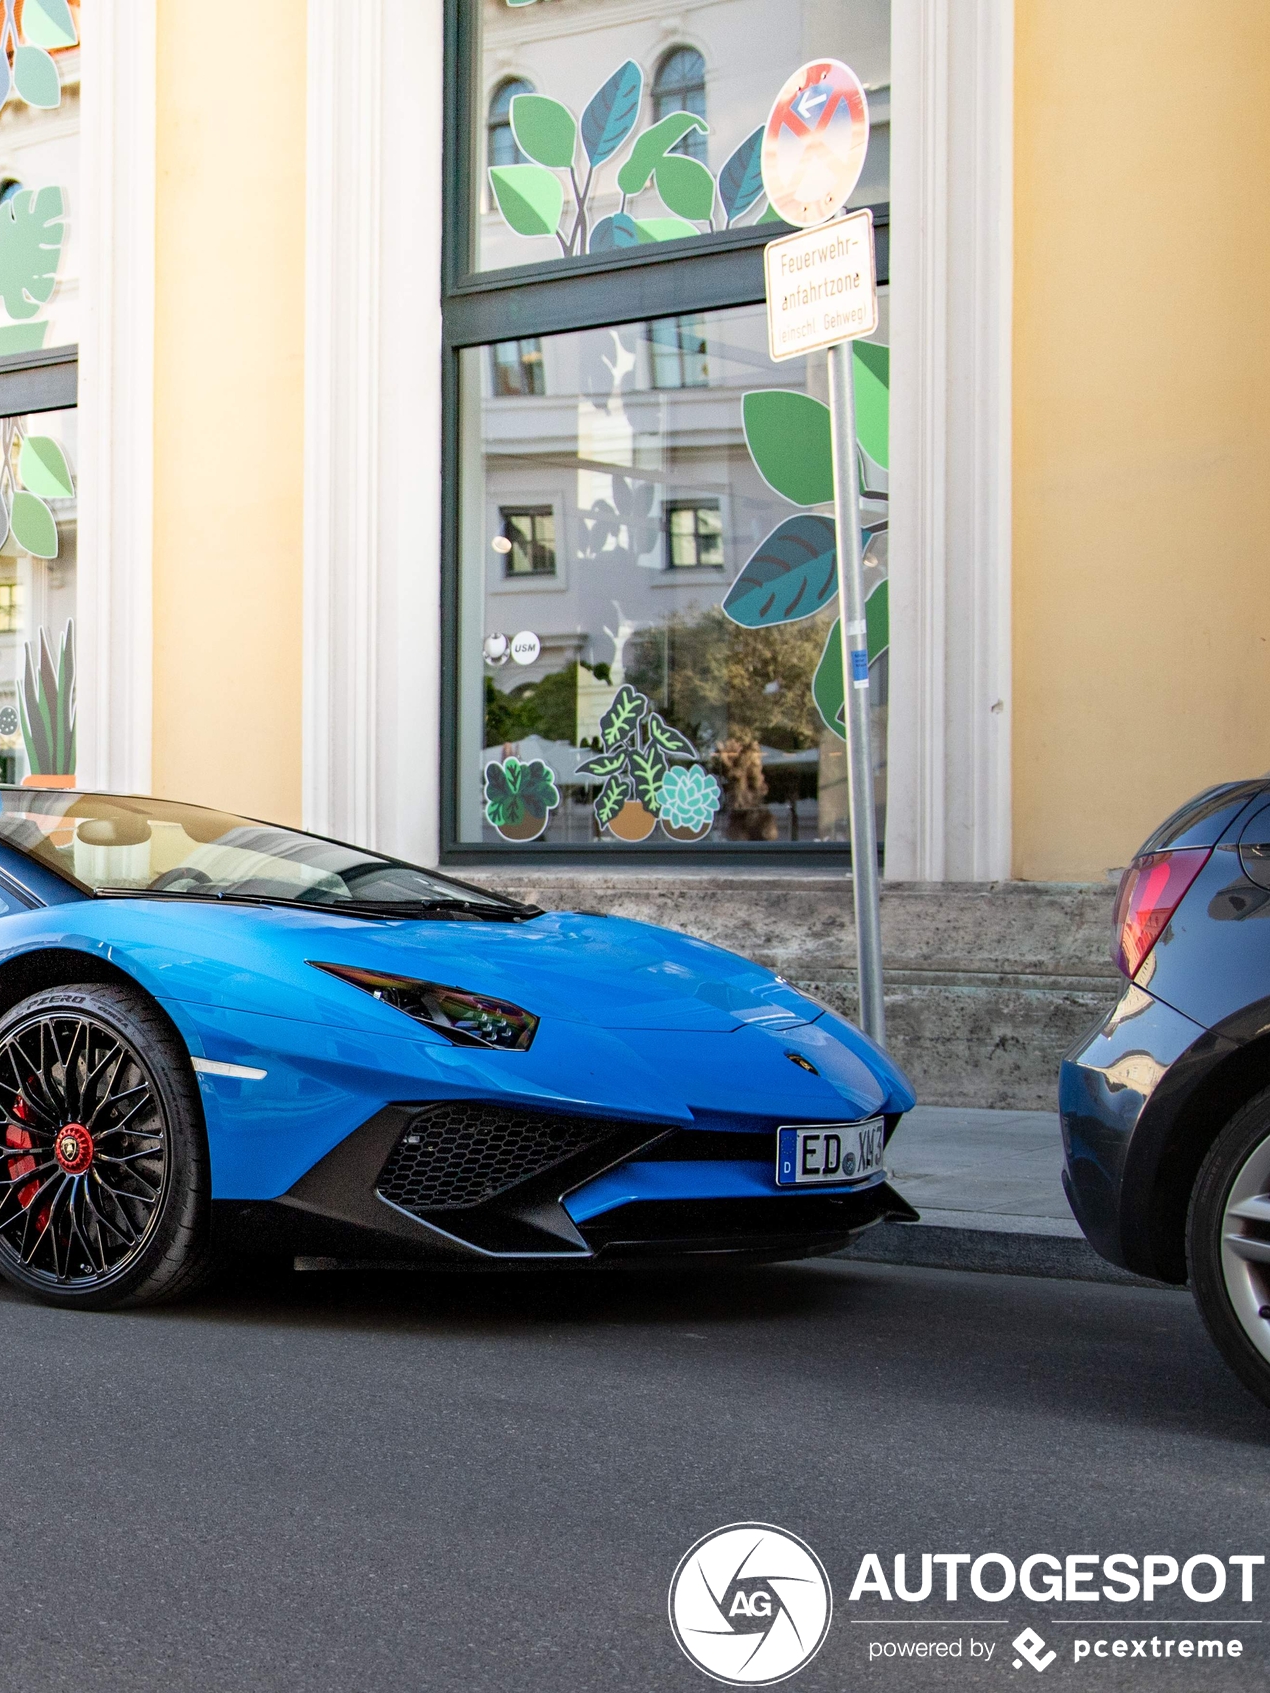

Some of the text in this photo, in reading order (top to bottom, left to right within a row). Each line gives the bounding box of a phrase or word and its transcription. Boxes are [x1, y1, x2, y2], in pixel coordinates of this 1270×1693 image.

[781, 236, 859, 276] Feuerwehr-
[781, 273, 860, 311] anfahrtzone
[823, 301, 867, 331] Gehweg)
[514, 643, 536, 653] USM
[783, 1161, 791, 1173] D
[802, 1133, 841, 1175] ED
